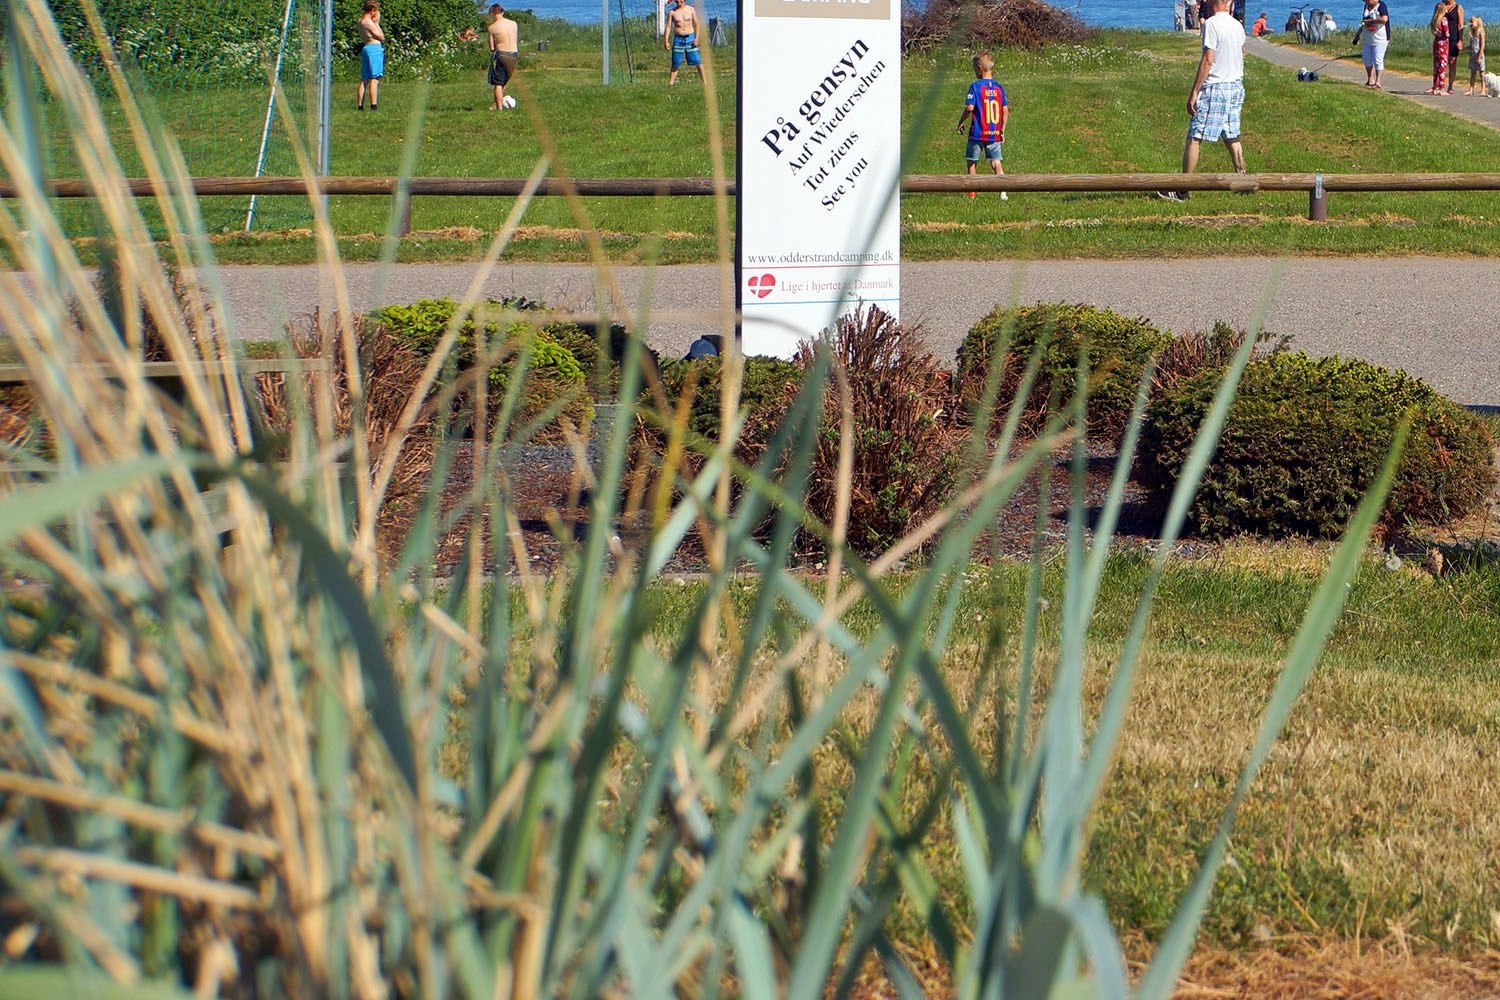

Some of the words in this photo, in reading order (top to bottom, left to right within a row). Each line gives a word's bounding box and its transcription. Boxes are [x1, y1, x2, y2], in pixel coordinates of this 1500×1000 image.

[760, 117, 801, 158] På
[799, 39, 870, 126] gensyn
[788, 142, 814, 176] Auf
[809, 59, 886, 147] Wiedersehen
[984, 99, 1000, 124] 10
[803, 165, 830, 192] Tot
[828, 131, 859, 168] ziens
[821, 184, 846, 212] See
[845, 157, 868, 188] you
[748, 250, 894, 264] www.odderstrandcamping.dk
[781, 281, 803, 294] Lige
[811, 280, 841, 293] hjertet
[854, 278, 894, 290] Danmark
